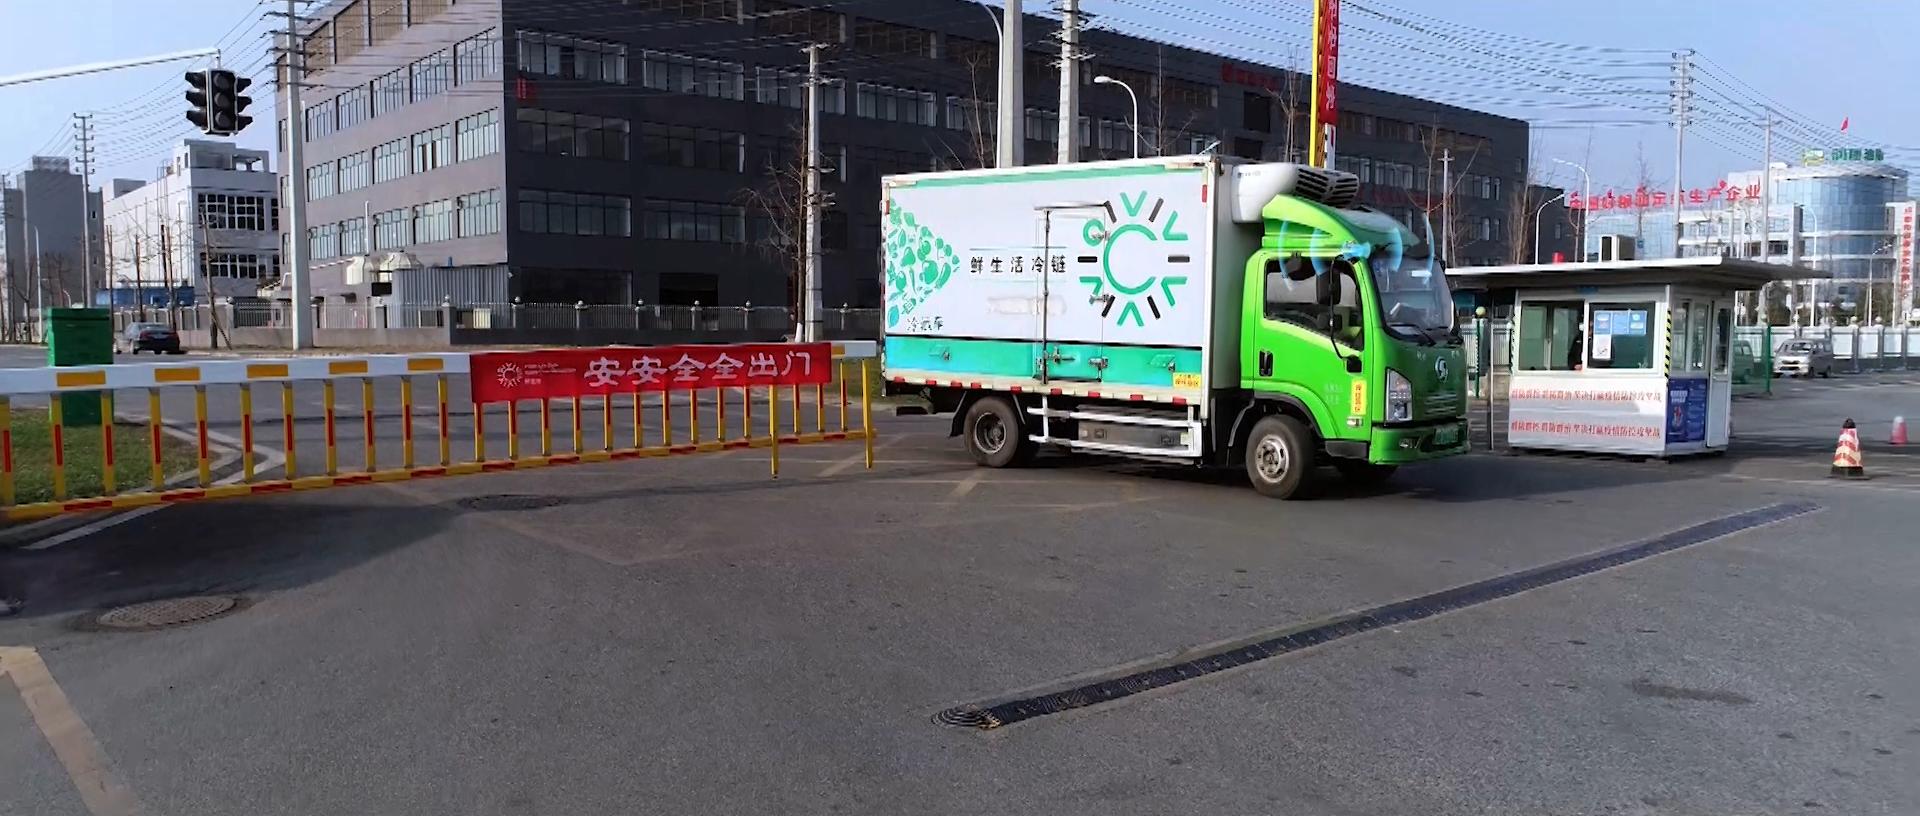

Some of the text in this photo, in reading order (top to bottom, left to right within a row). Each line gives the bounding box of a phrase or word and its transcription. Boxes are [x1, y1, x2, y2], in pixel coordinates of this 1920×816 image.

[970, 254, 1066, 274] 鲜生活冷链
[583, 351, 812, 388] 安安全全出门
